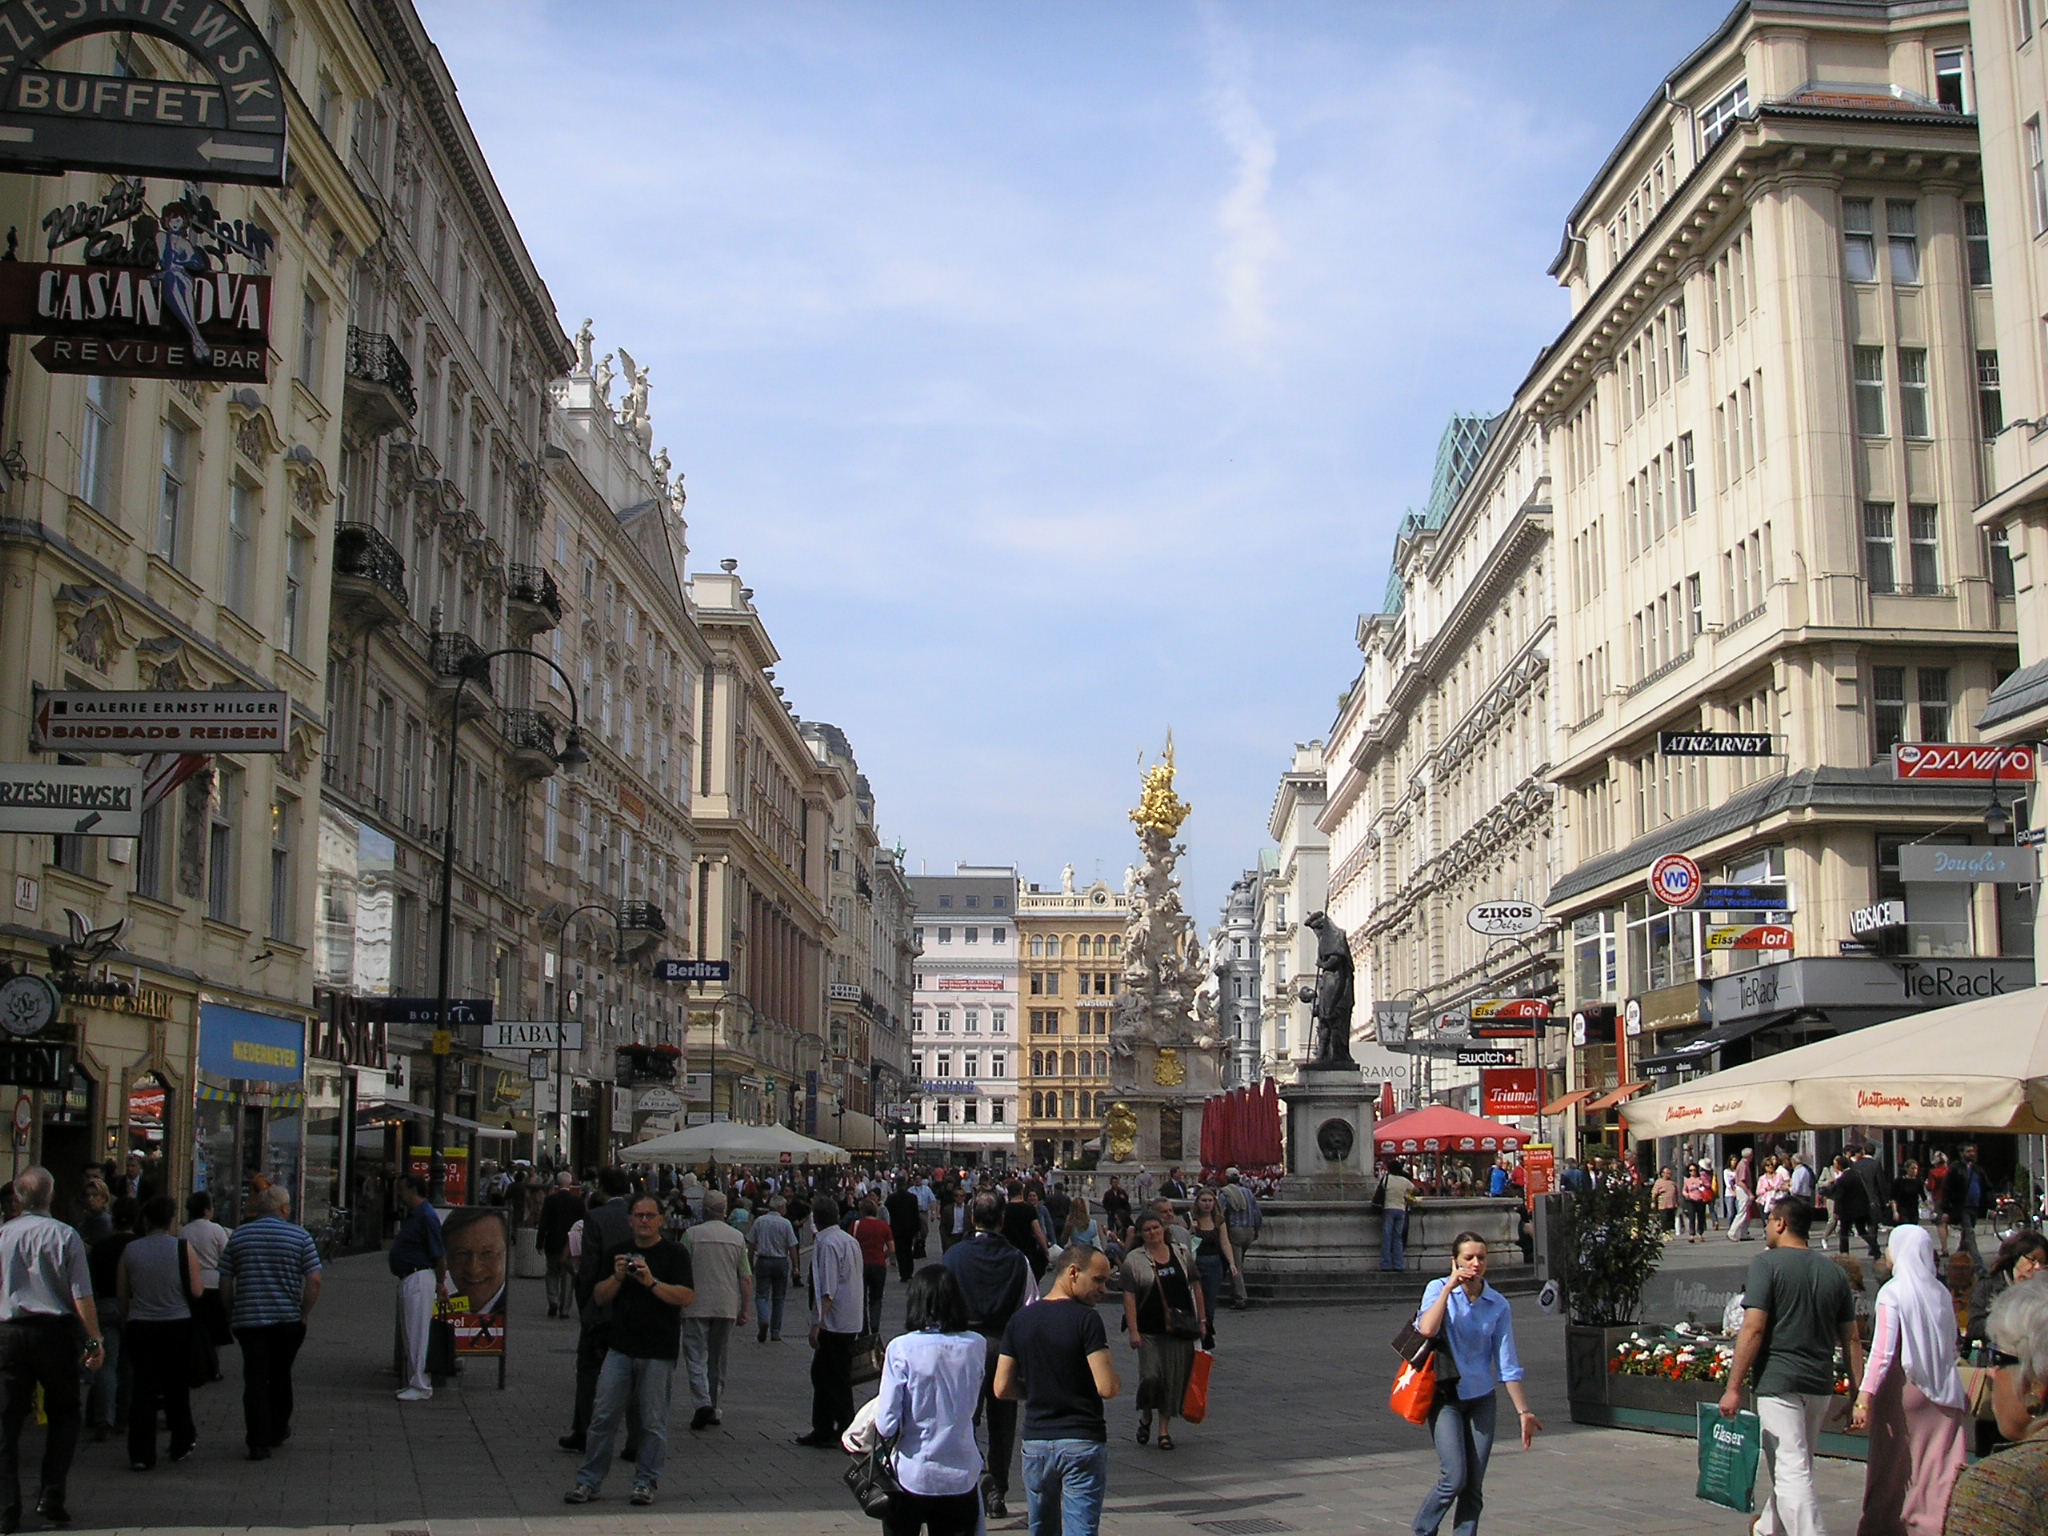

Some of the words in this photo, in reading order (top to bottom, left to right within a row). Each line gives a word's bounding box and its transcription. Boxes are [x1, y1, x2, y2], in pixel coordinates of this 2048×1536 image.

[18, 74, 220, 123] BUFFET
[53, 341, 184, 365] REVUE
[212, 350, 260, 369] BAR
[74, 703, 147, 713] GALERIE
[153, 703, 209, 713] ERNST
[214, 703, 279, 713] HILGER
[52, 726, 181, 739] SINDBADS
[189, 726, 278, 739] REISEN
[1478, 907, 1532, 919] ZIKOS
[1849, 902, 1890, 935] VERSACE
[1485, 918, 1523, 932] Pelze
[1711, 933, 1760, 945] Eissalon
[666, 962, 721, 977] Berlitz
[499, 1025, 568, 1046] HABAN
[1458, 1052, 1506, 1064] swatch
